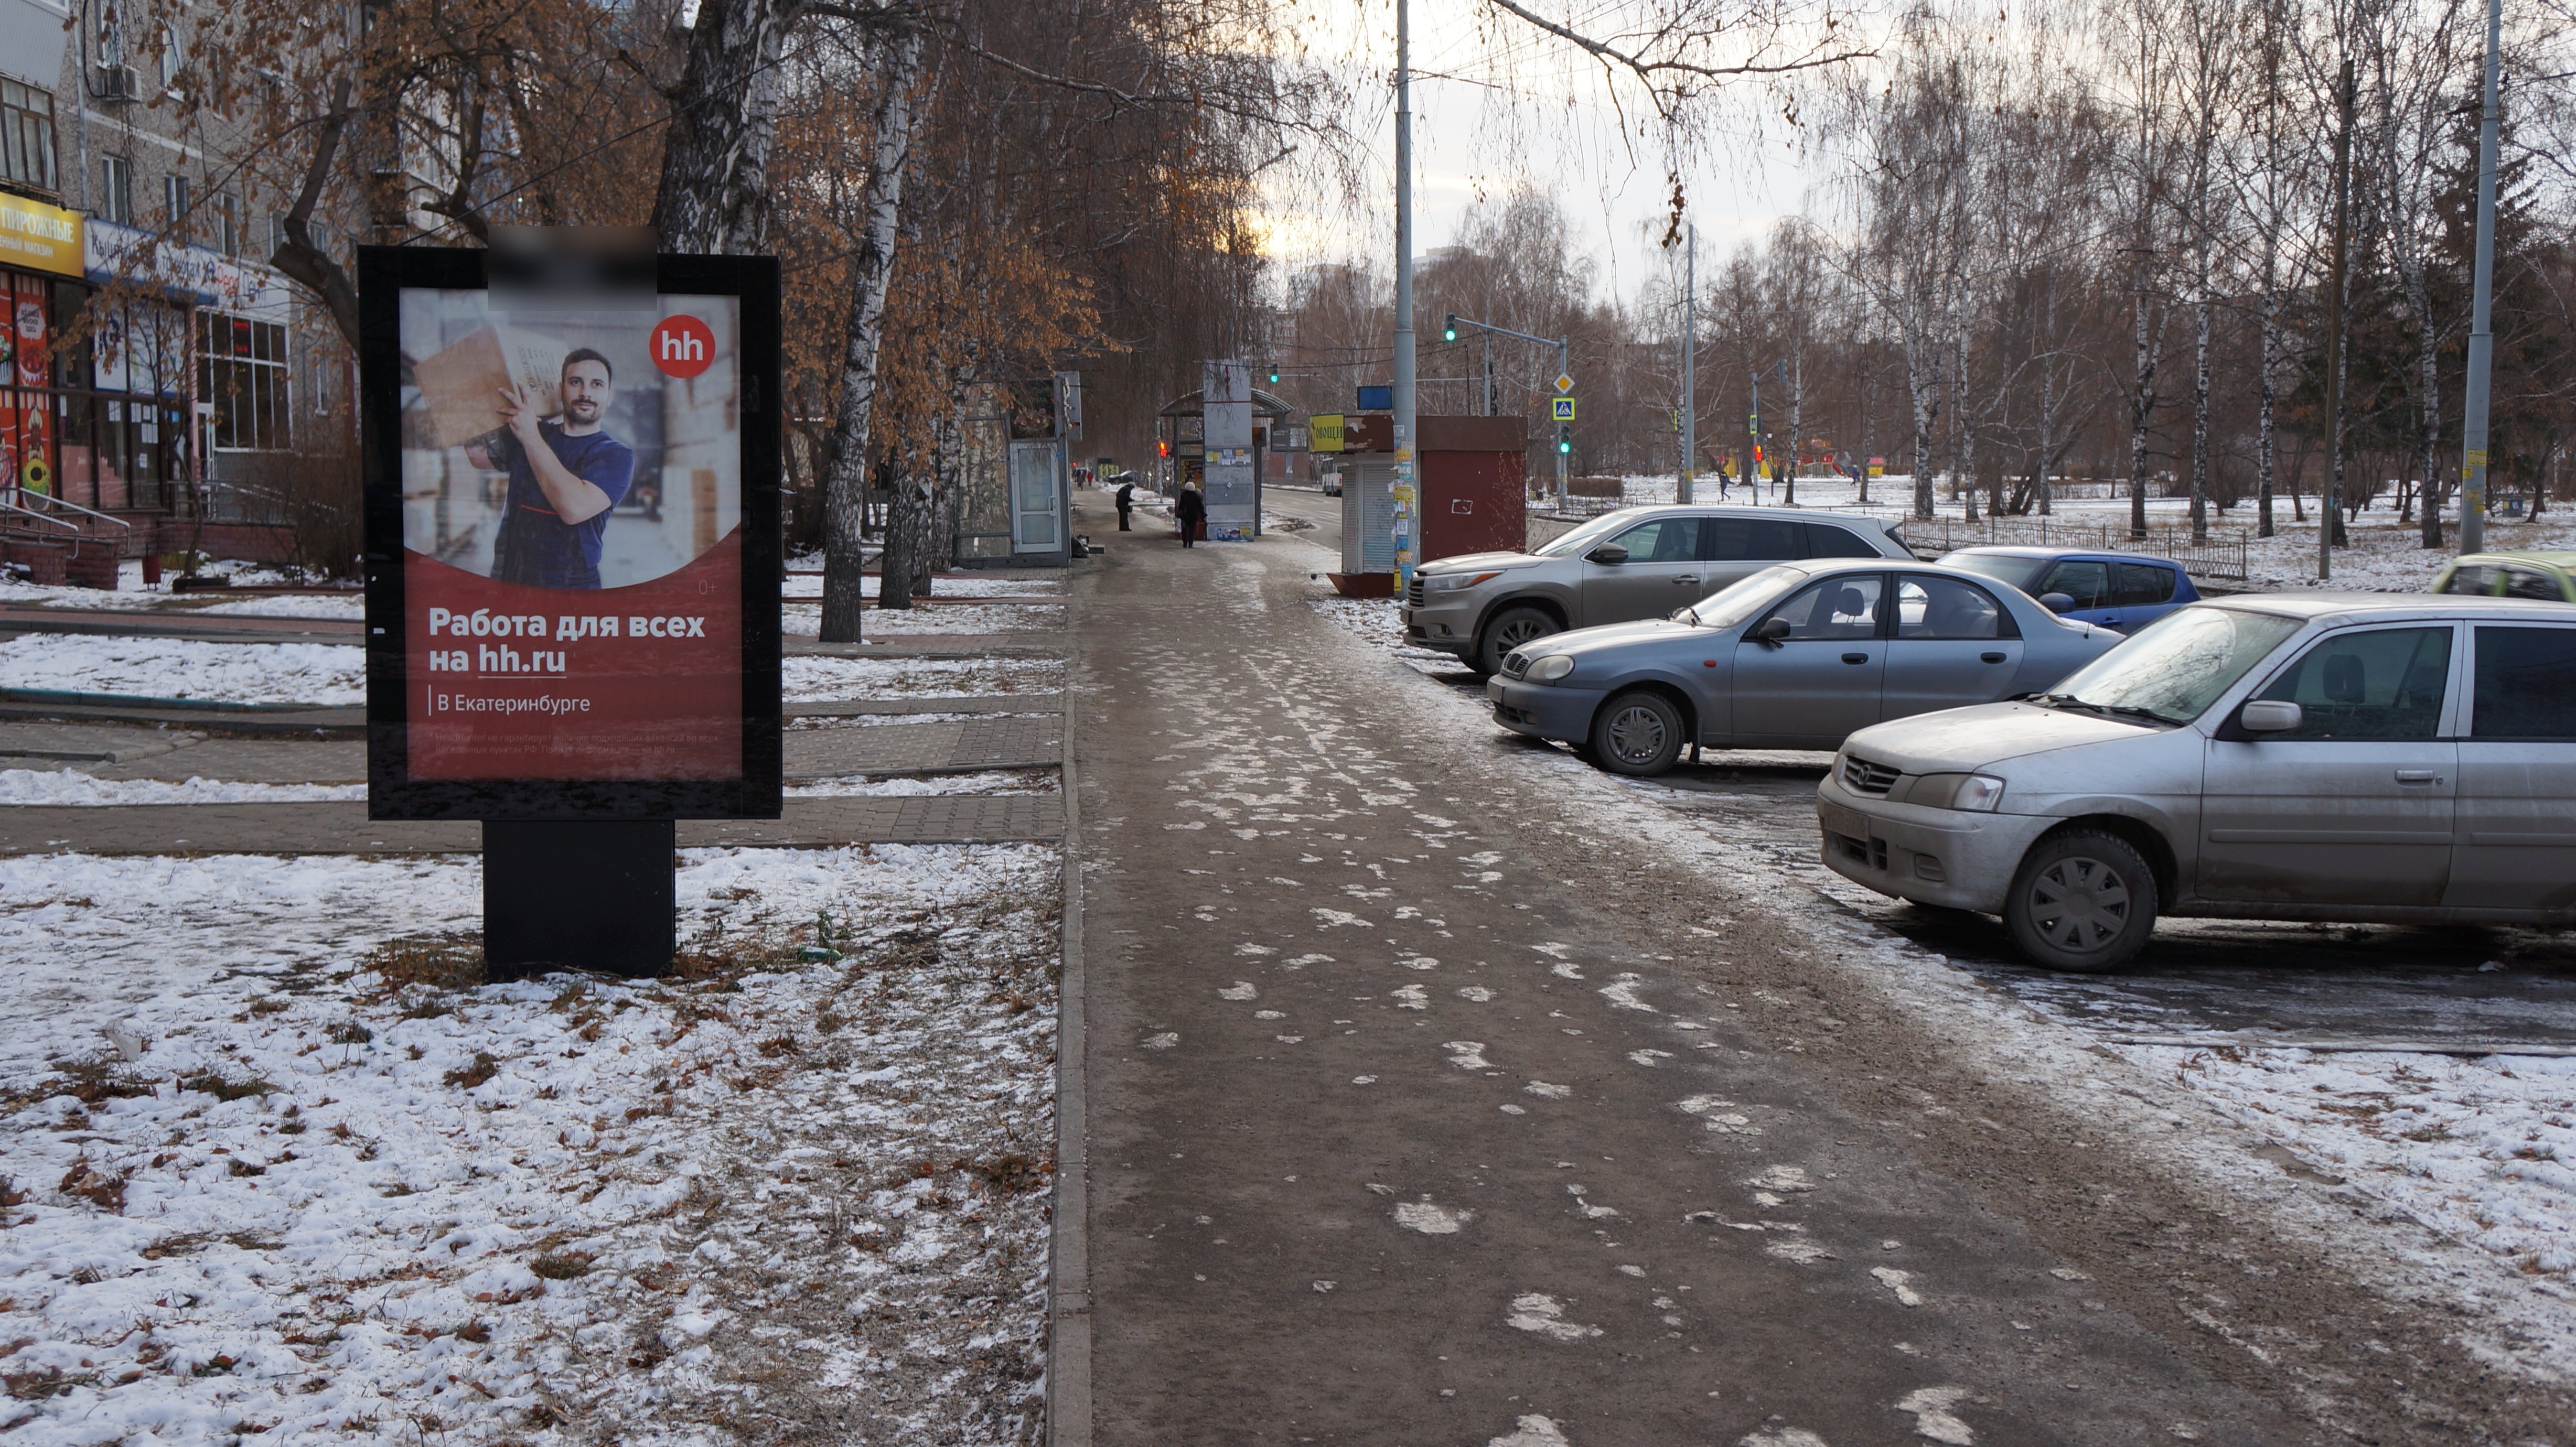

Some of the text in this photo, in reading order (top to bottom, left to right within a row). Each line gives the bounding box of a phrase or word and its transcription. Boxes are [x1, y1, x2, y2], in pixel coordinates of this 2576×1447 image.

[2, 206, 74, 243] ПИРОЖНЫЕ
[25, 240, 53, 258] МАГАЗИН
[662, 330, 703, 361] hh
[1316, 426, 1343, 441] ОВОЩИ
[699, 580, 717, 595] 0+
[429, 607, 705, 641] Работа для всех
[430, 644, 565, 672] на hh.ru
[438, 694, 591, 715] В Екатеринбурге
